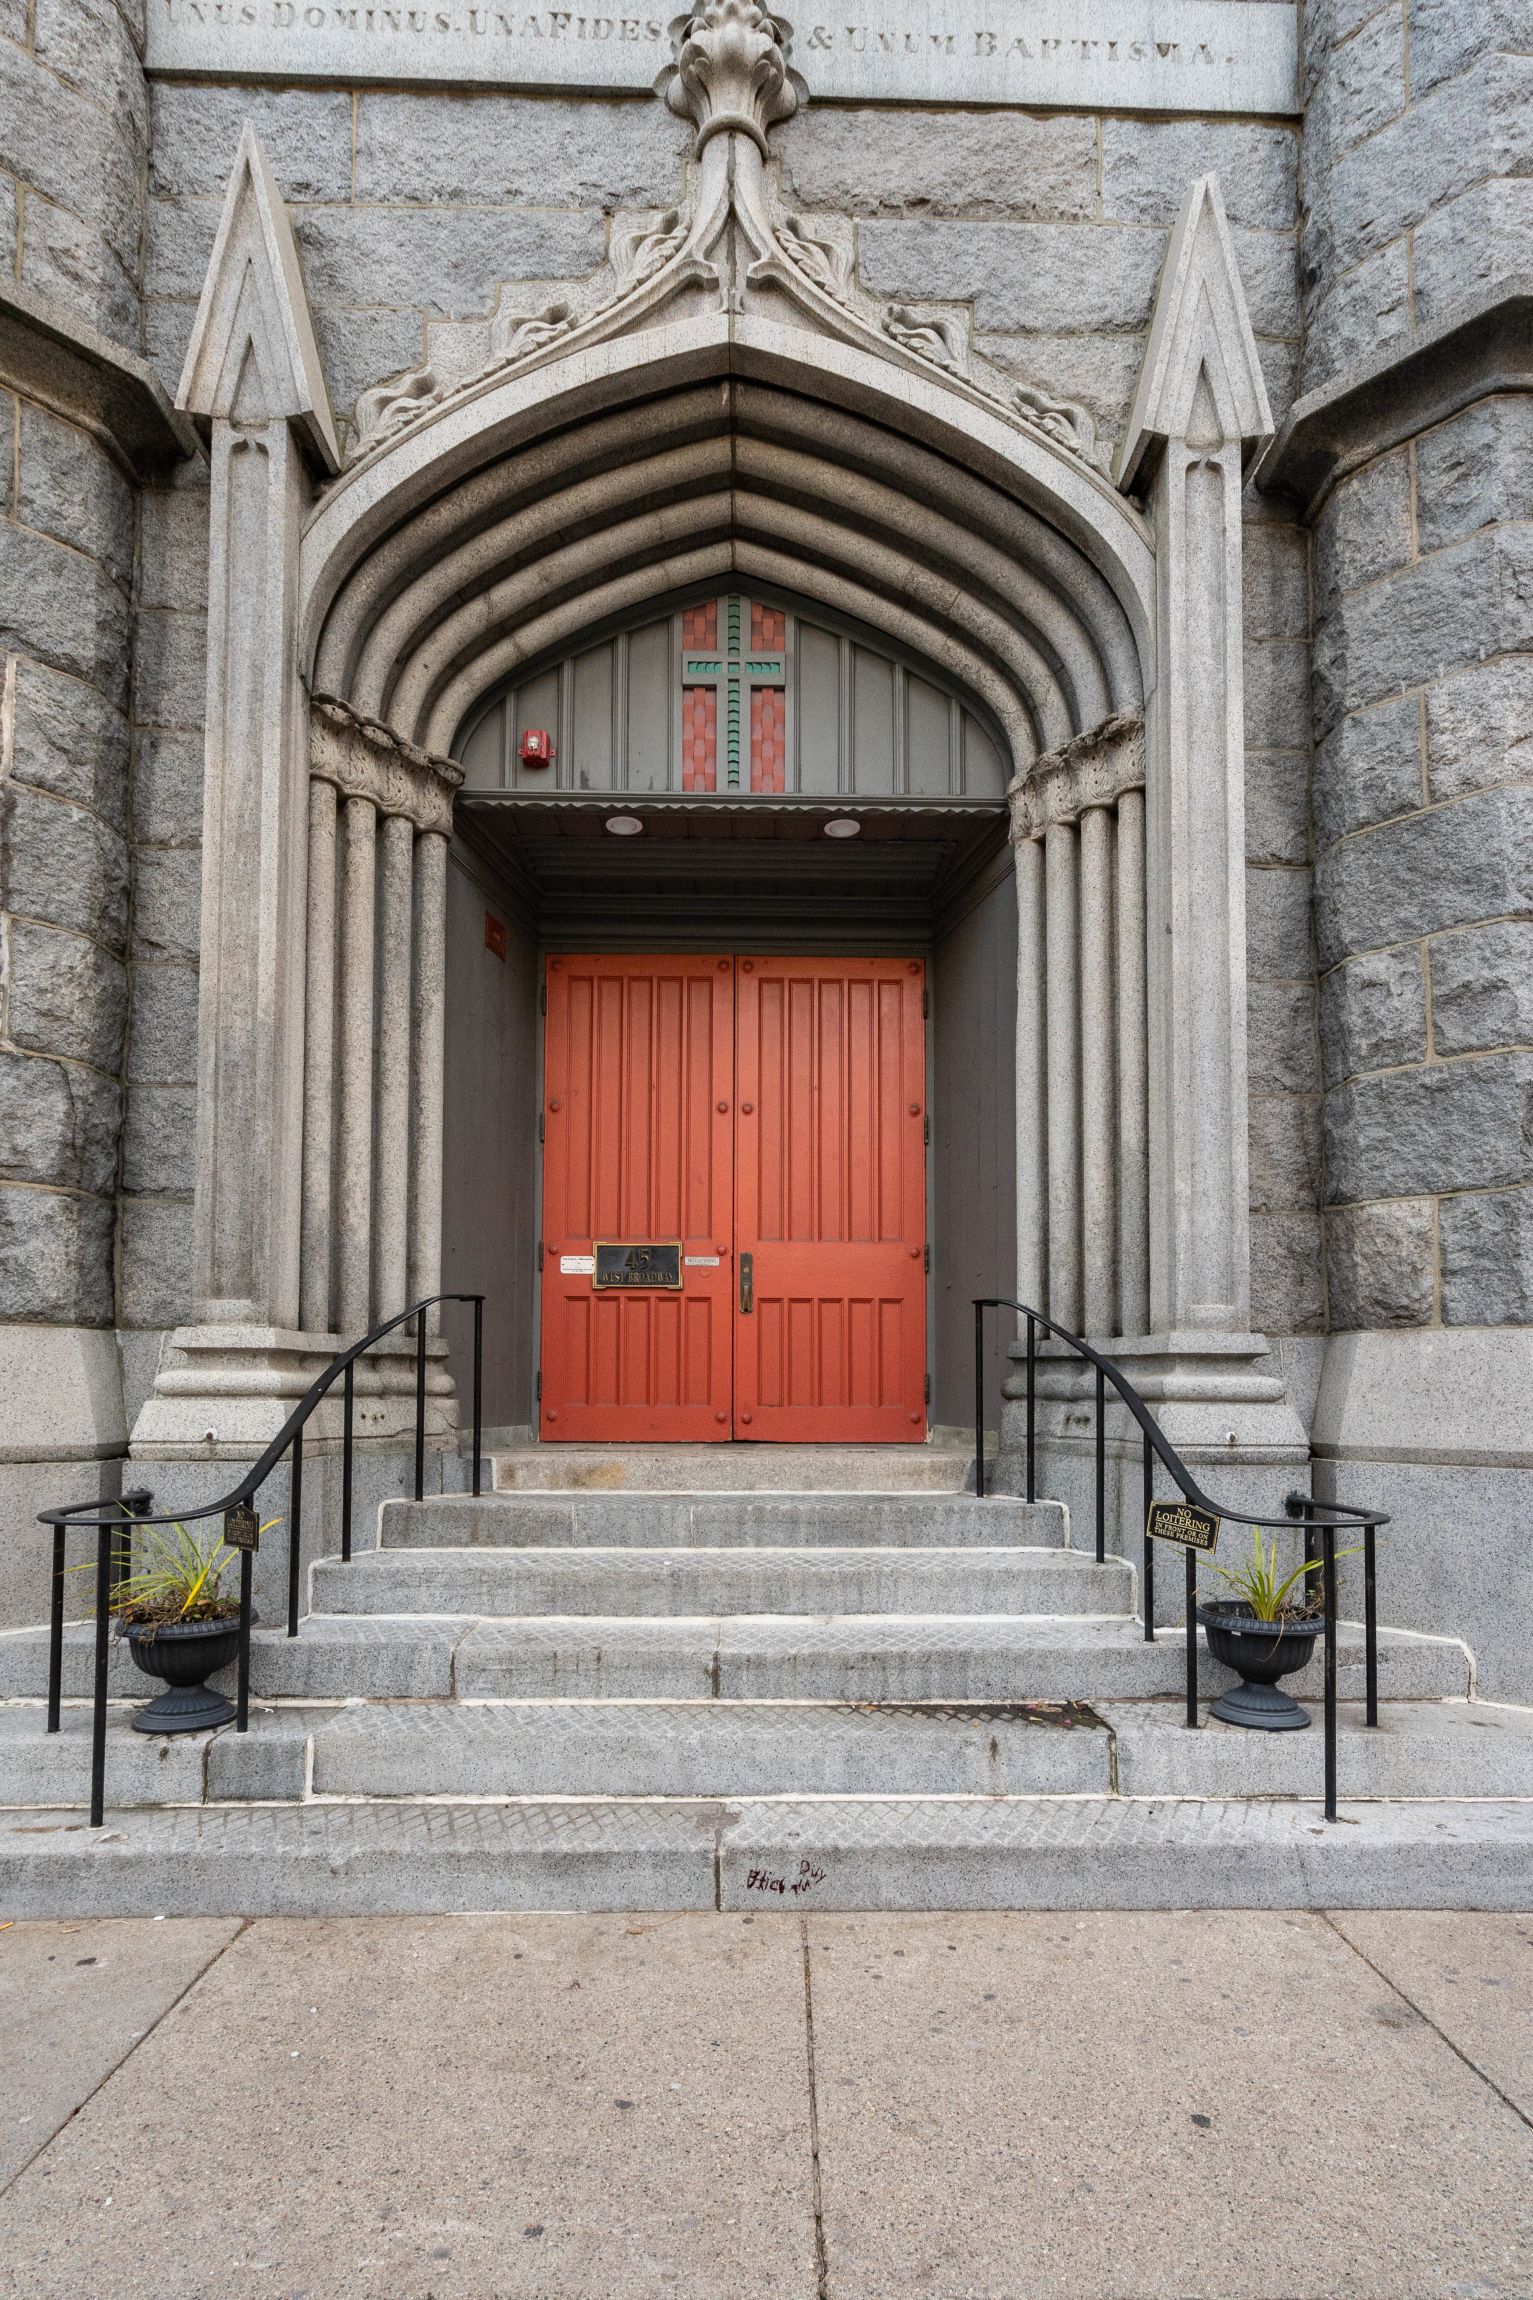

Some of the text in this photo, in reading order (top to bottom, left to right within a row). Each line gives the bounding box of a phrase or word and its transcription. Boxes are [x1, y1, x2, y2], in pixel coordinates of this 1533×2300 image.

[806, 26, 834, 51] &
[845, 27, 956, 56] UNUM
[624, 1248, 651, 1271] 45
[602, 1271, 673, 1284] WEST BROADWAY
[1156, 1511, 1210, 1532] LOITERING
[1176, 1507, 1192, 1519] NO
[1154, 1526, 1209, 1547] THESE PREMISES
[1164, 1523, 1186, 1535] FRONT
[1187, 1529, 1197, 1538] OR
[1198, 1532, 1209, 1541] ON
